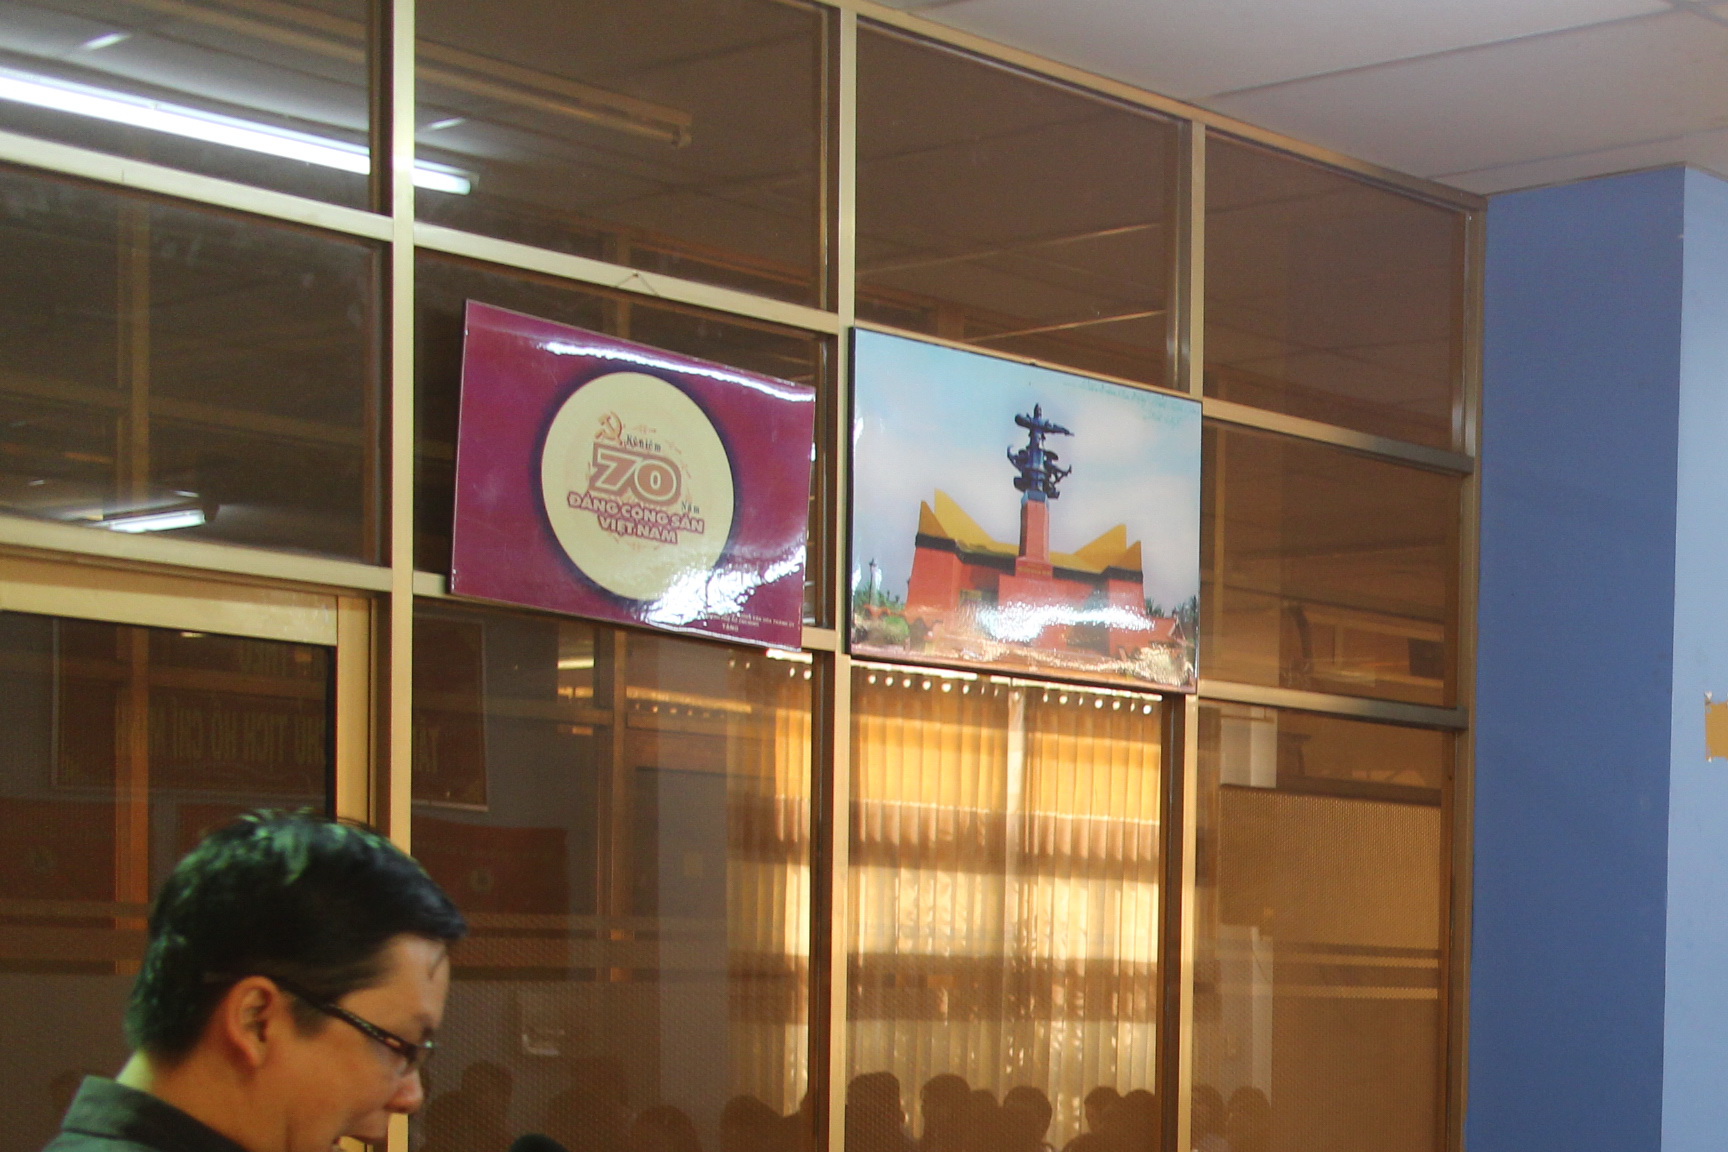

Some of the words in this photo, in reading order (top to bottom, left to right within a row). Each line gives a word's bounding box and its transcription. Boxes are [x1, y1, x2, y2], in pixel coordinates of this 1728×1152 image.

[587, 442, 682, 507] 70
[567, 490, 620, 517] ĐẢNG
[669, 512, 705, 534] SẢN
[597, 514, 636, 538] VIỆT
[636, 520, 678, 544] NAM
